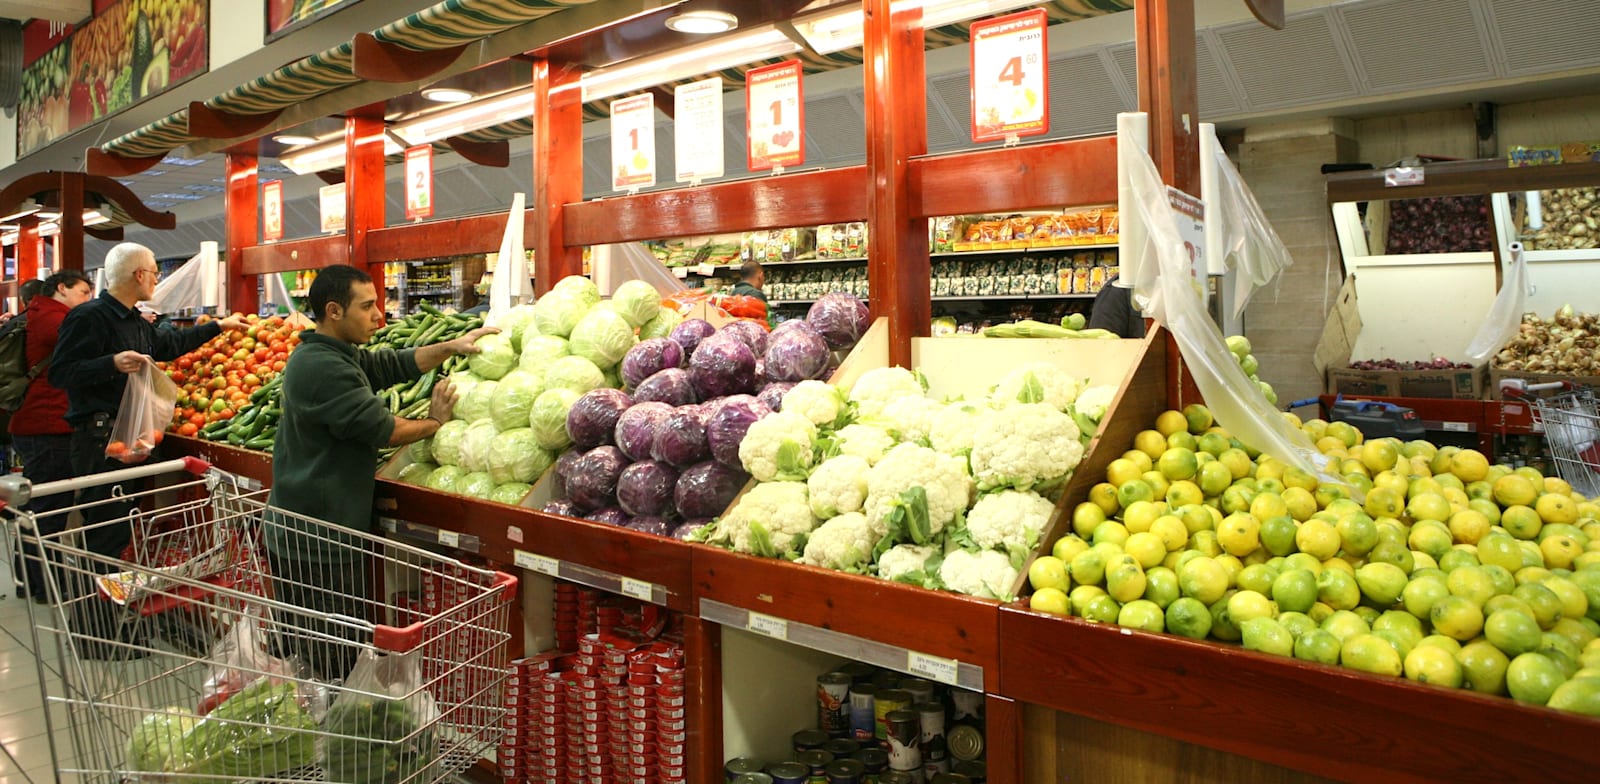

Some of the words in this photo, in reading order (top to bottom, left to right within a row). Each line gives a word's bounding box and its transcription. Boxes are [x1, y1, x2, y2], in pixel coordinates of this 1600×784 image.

[998, 56, 1025, 87] 4
[769, 100, 782, 126] 1
[628, 128, 638, 150] 1
[415, 171, 424, 189] 2
[270, 201, 277, 217] 2
